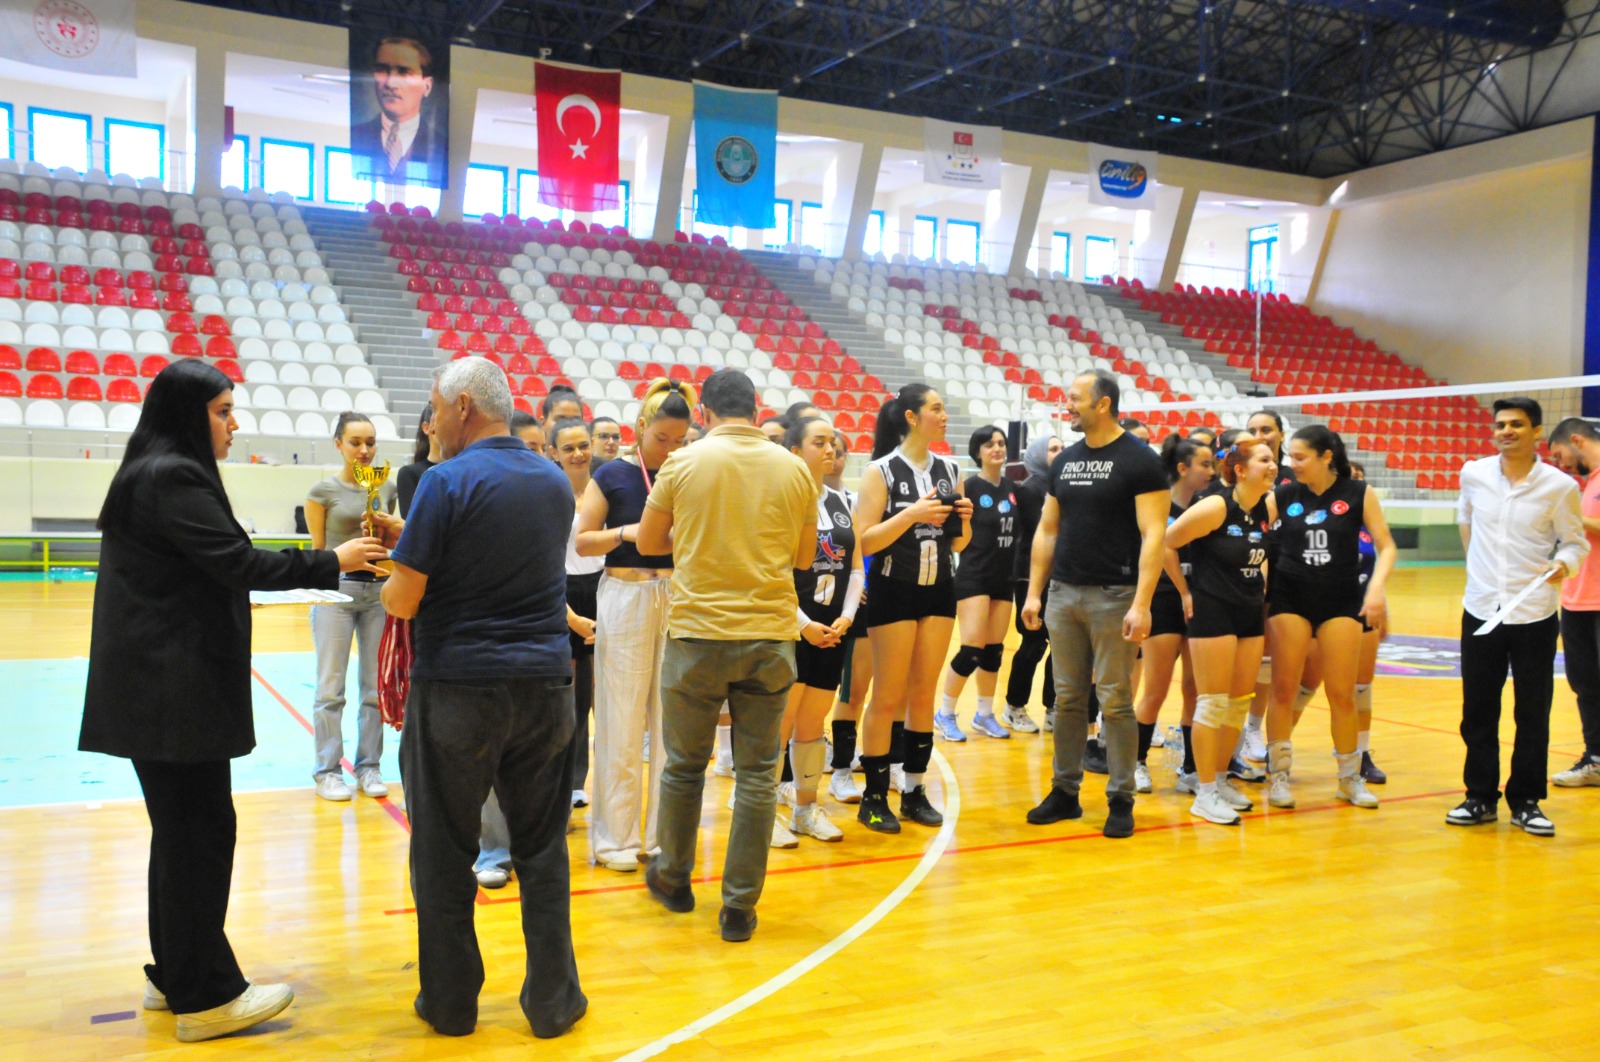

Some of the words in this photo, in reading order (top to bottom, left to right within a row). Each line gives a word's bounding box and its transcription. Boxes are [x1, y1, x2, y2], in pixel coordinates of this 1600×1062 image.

[1062, 461, 1085, 473] FIND
[1086, 460, 1114, 473] YOUR
[1060, 472, 1092, 480] CREATIVE
[1093, 472, 1110, 480] SIDE
[899, 481, 910, 495] 8
[1000, 516, 1014, 533] 14
[998, 535, 1014, 548] TIP
[1305, 529, 1328, 549] 10
[1302, 552, 1331, 566] TIP
